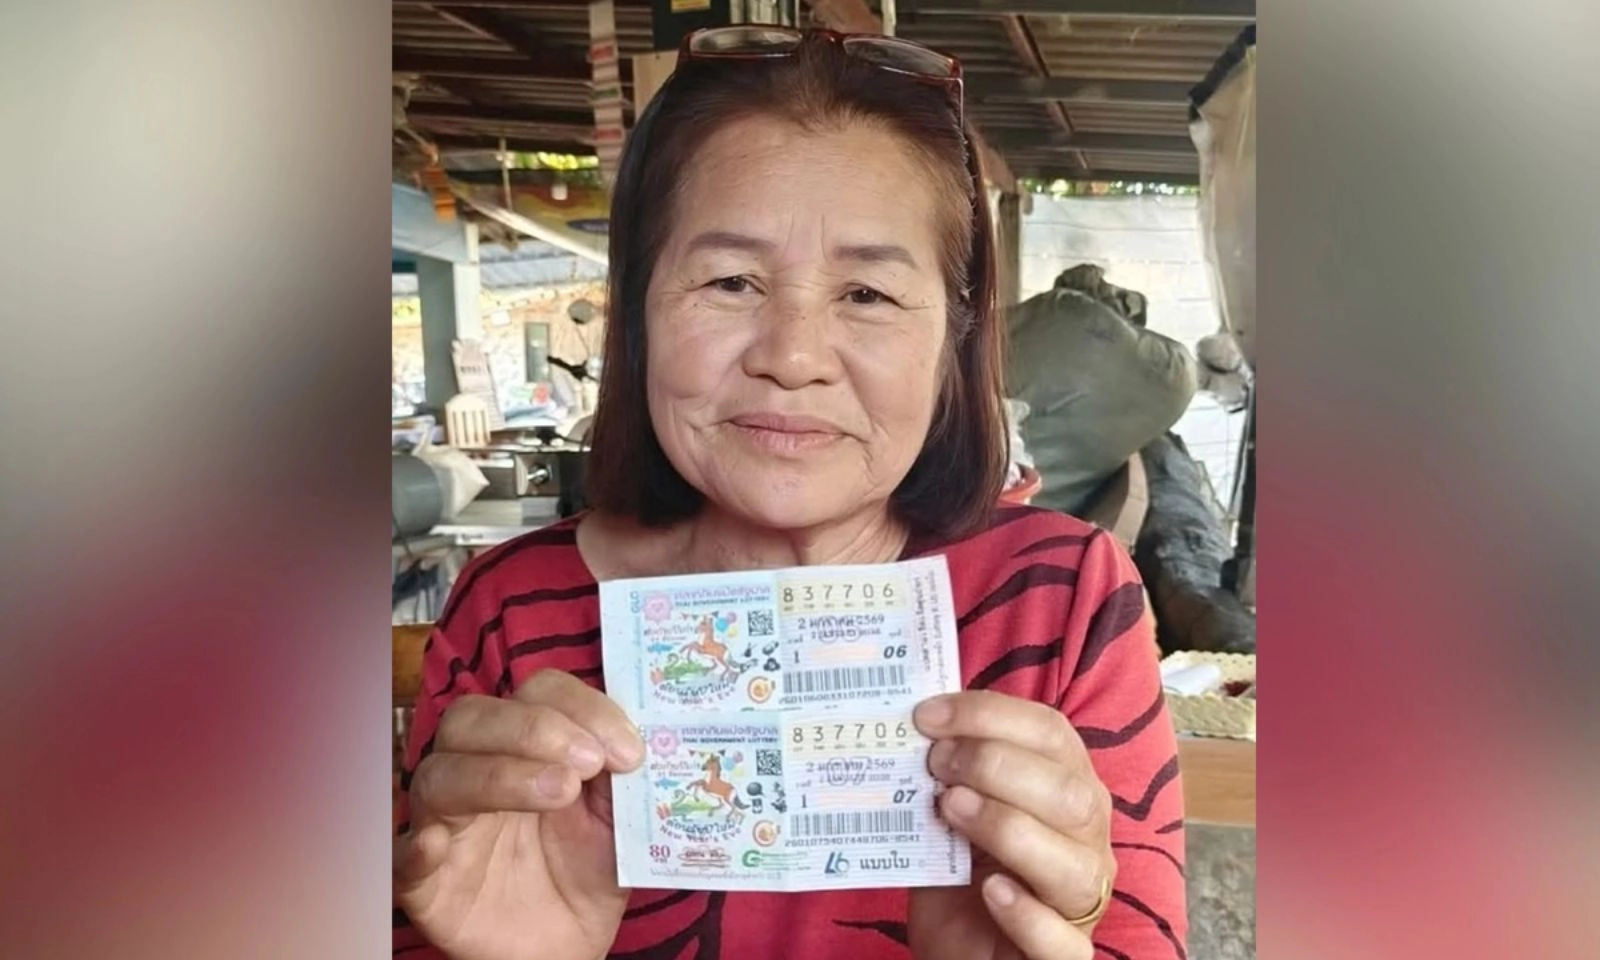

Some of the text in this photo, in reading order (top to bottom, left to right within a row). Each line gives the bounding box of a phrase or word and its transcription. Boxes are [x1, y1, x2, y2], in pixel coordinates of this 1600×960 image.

[783, 583, 894, 603] 837706
[798, 618, 806, 629] 2
[856, 614, 885, 625] 2569
[883, 645, 907, 659] 06
[792, 722, 907, 744] 837706
[806, 762, 814, 773] 2
[867, 759, 896, 770] 2569
[893, 790, 917, 804] 07
[659, 824, 682, 840] New
[649, 844, 671, 858] 80
